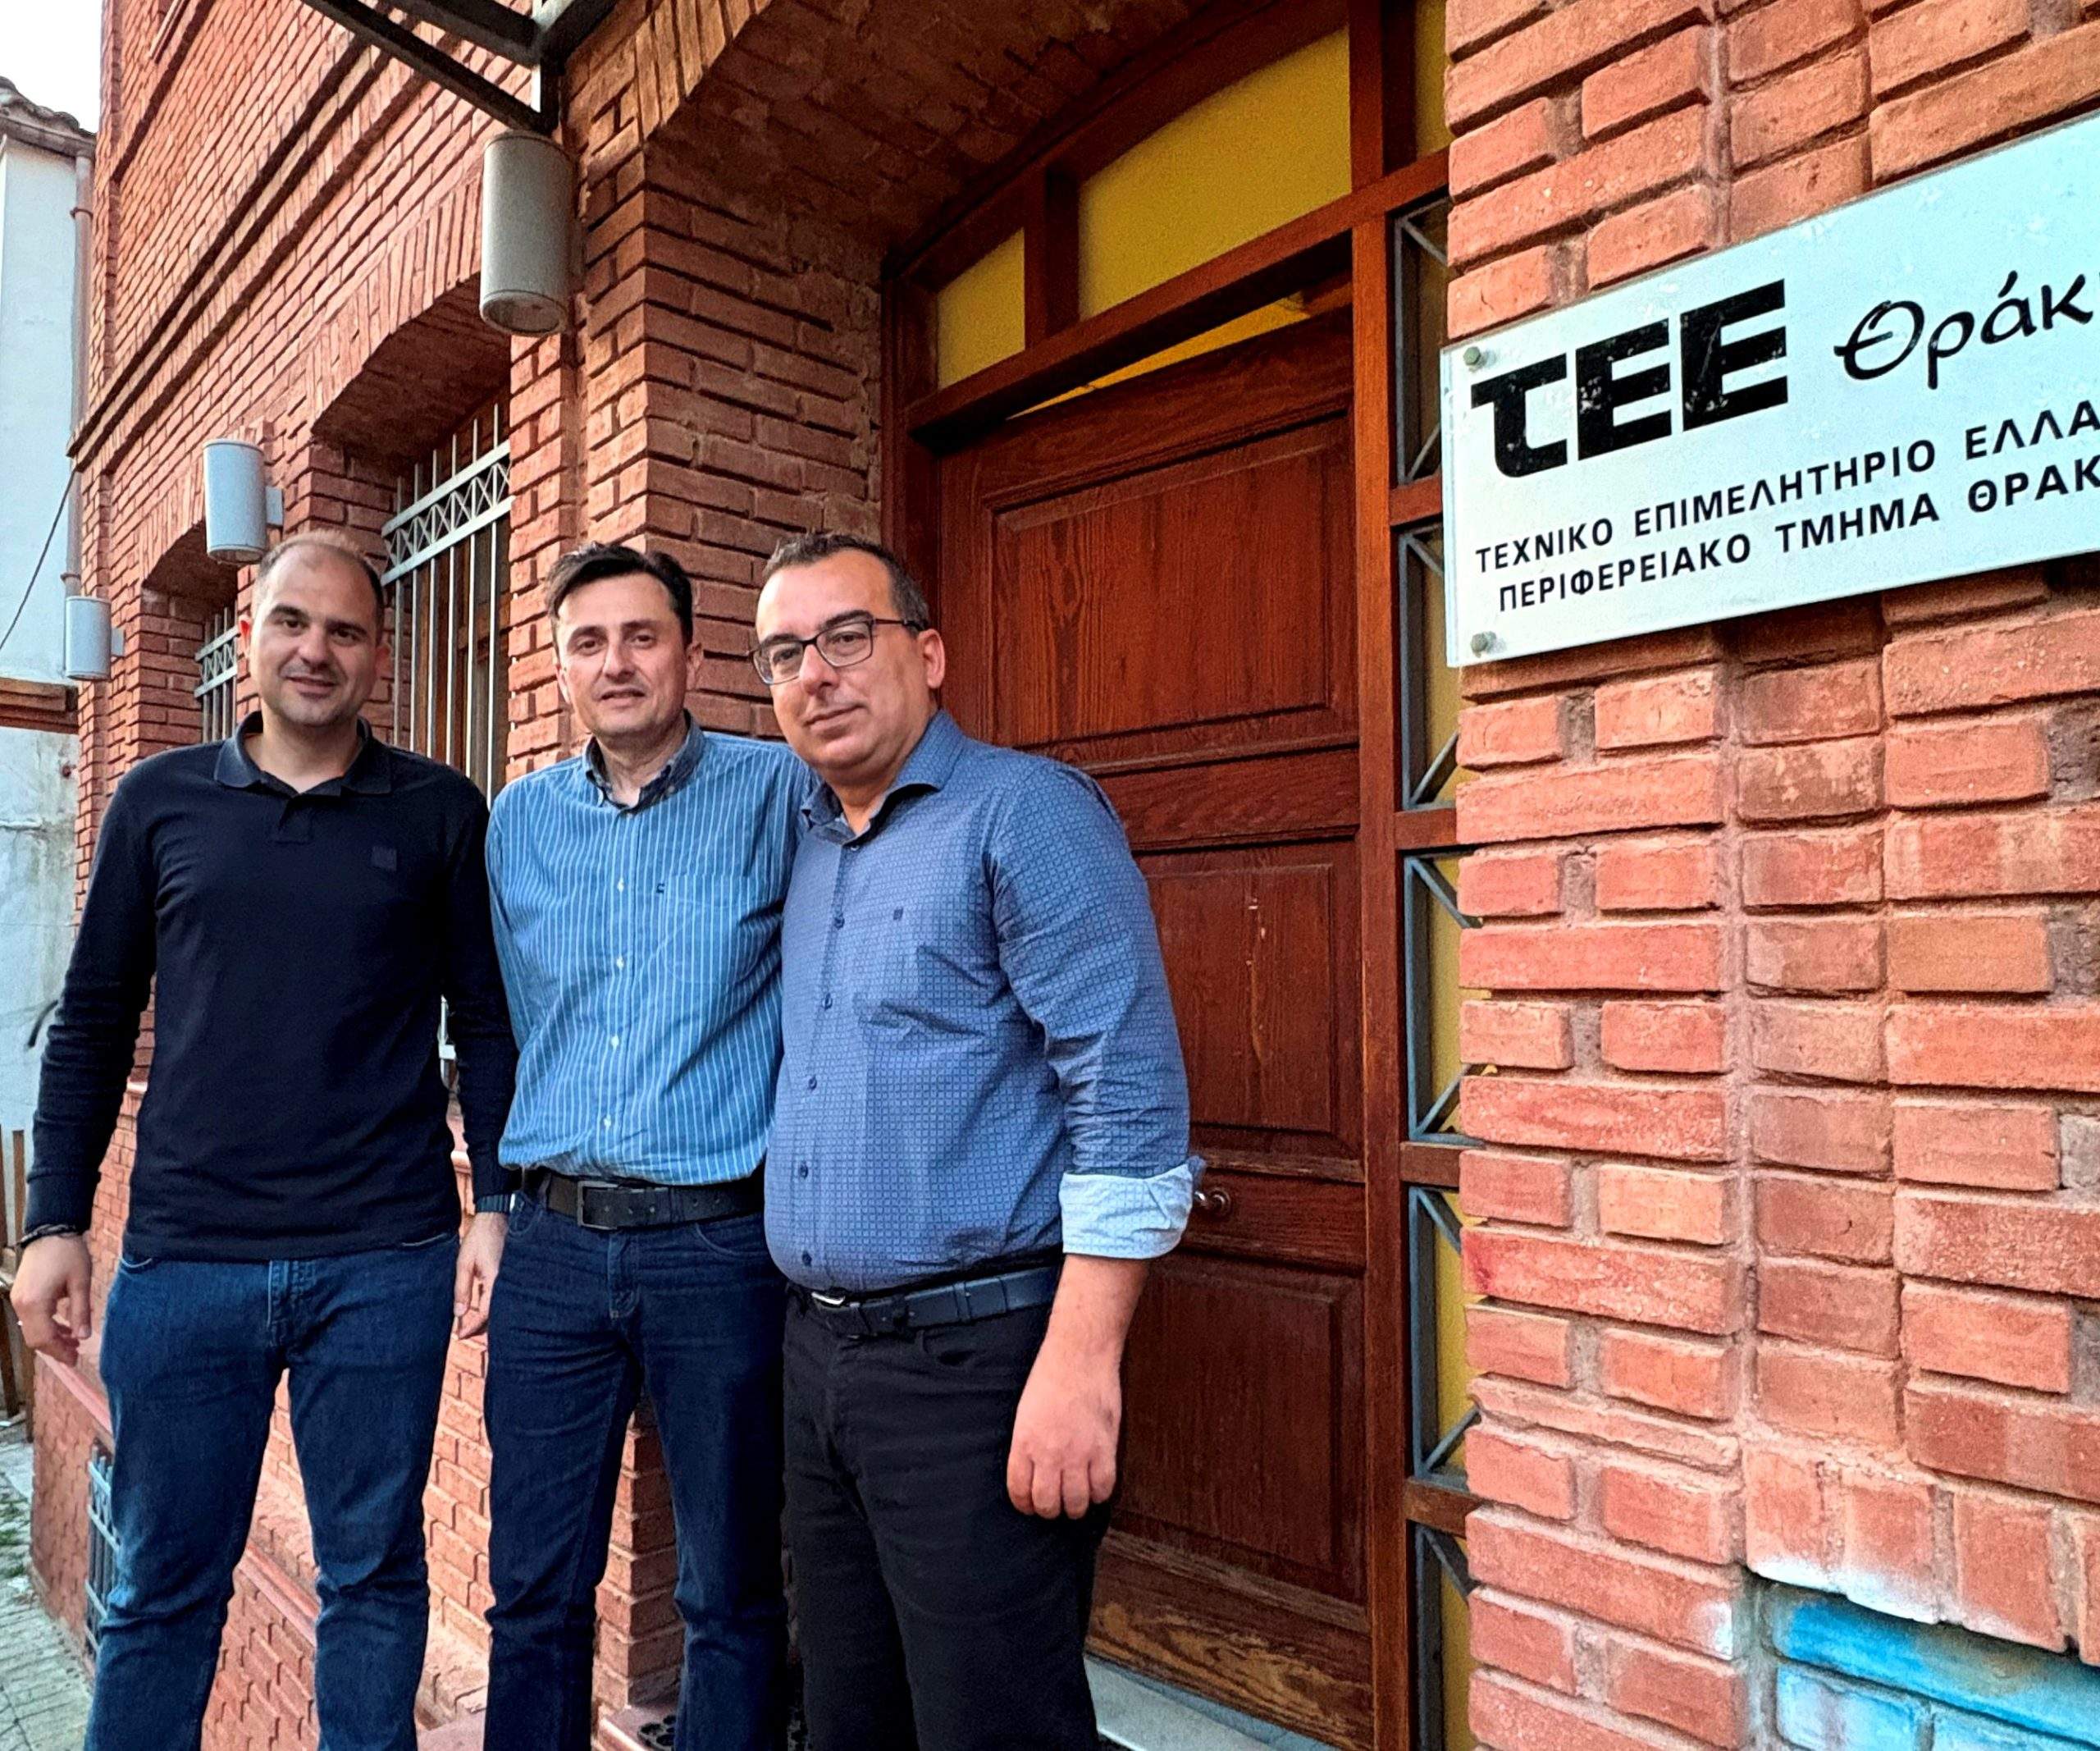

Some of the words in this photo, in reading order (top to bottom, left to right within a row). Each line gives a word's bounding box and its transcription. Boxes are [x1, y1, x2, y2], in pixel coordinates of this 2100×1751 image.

[1833, 270, 2100, 391] Θράκ
[1476, 518, 1614, 574] ΤΕΧΝΙΚΟ
[1634, 439, 1935, 537] ΕΠΙΜΕΛΗΤΗΡΙΟ
[1965, 400, 2100, 461] ΕΛΛΑ
[1500, 538, 1751, 612] ΠΕΡΙΦΕΡΕΙΑΚΟ
[1774, 492, 1940, 554] ΤΜΗΜΑ
[1967, 454, 2100, 514] ΘΡΑΚ
